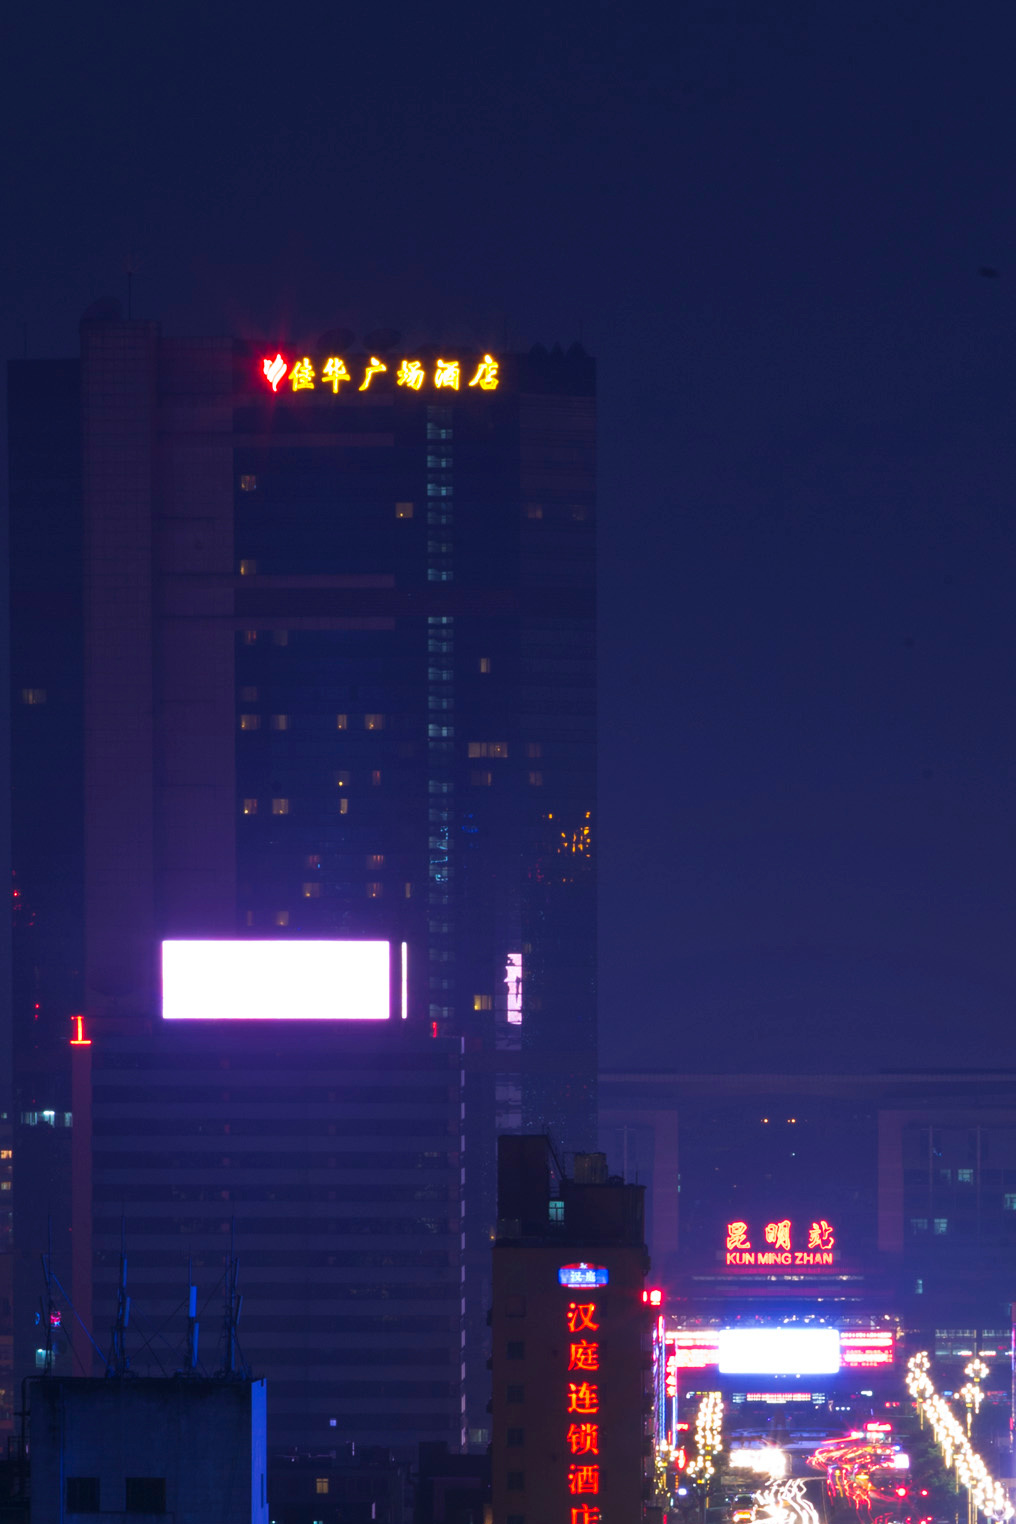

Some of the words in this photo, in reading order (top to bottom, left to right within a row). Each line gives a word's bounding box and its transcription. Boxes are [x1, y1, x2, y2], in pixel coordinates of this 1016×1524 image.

[288, 353, 500, 394] 佳华广场酒店
[726, 1219, 835, 1251] 昆明站
[726, 1252, 755, 1265] KUN
[757, 1252, 792, 1265] MING
[794, 1252, 833, 1265] ZHAN
